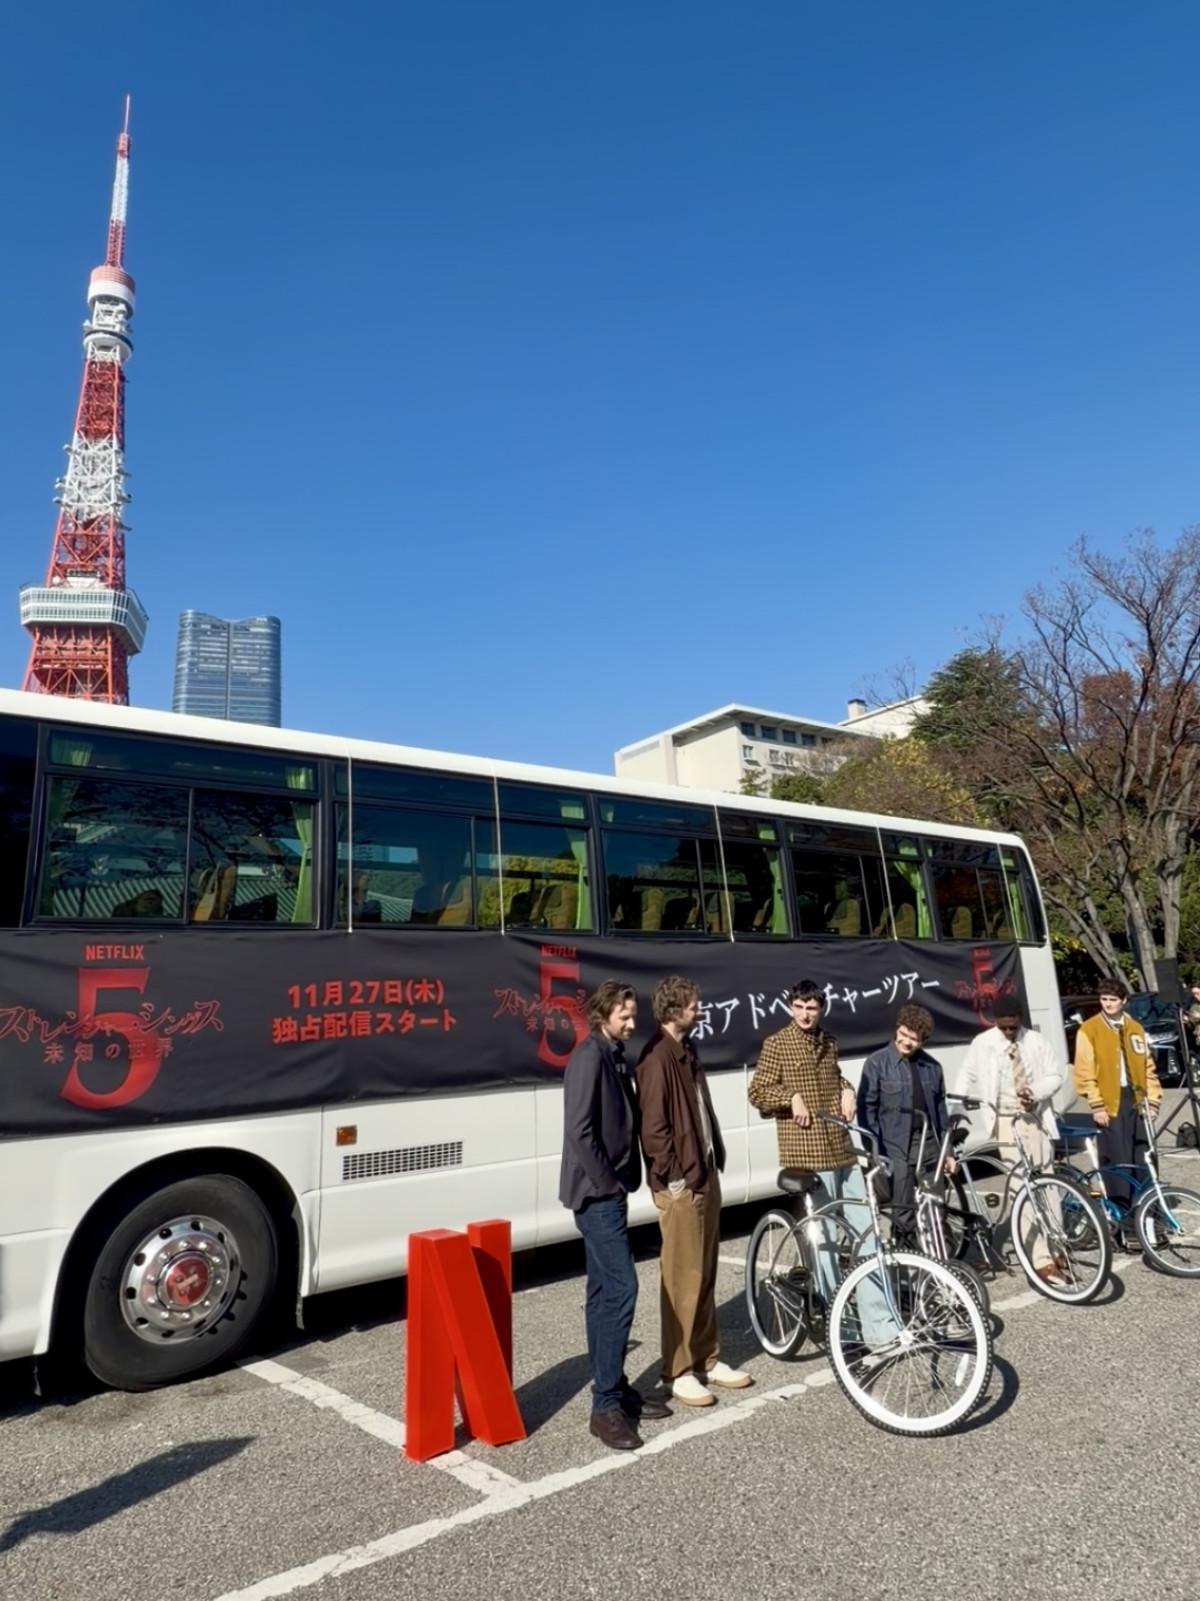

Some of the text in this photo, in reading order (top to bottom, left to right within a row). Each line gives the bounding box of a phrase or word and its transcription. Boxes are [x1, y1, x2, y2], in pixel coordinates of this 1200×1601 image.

[85, 945, 145, 960] NETFLIX
[541, 945, 577, 957] NETFLIX
[689, 972, 941, 1041] 京アドベチャーツアー
[272, 1008, 457, 1044] 独占配信スタート
